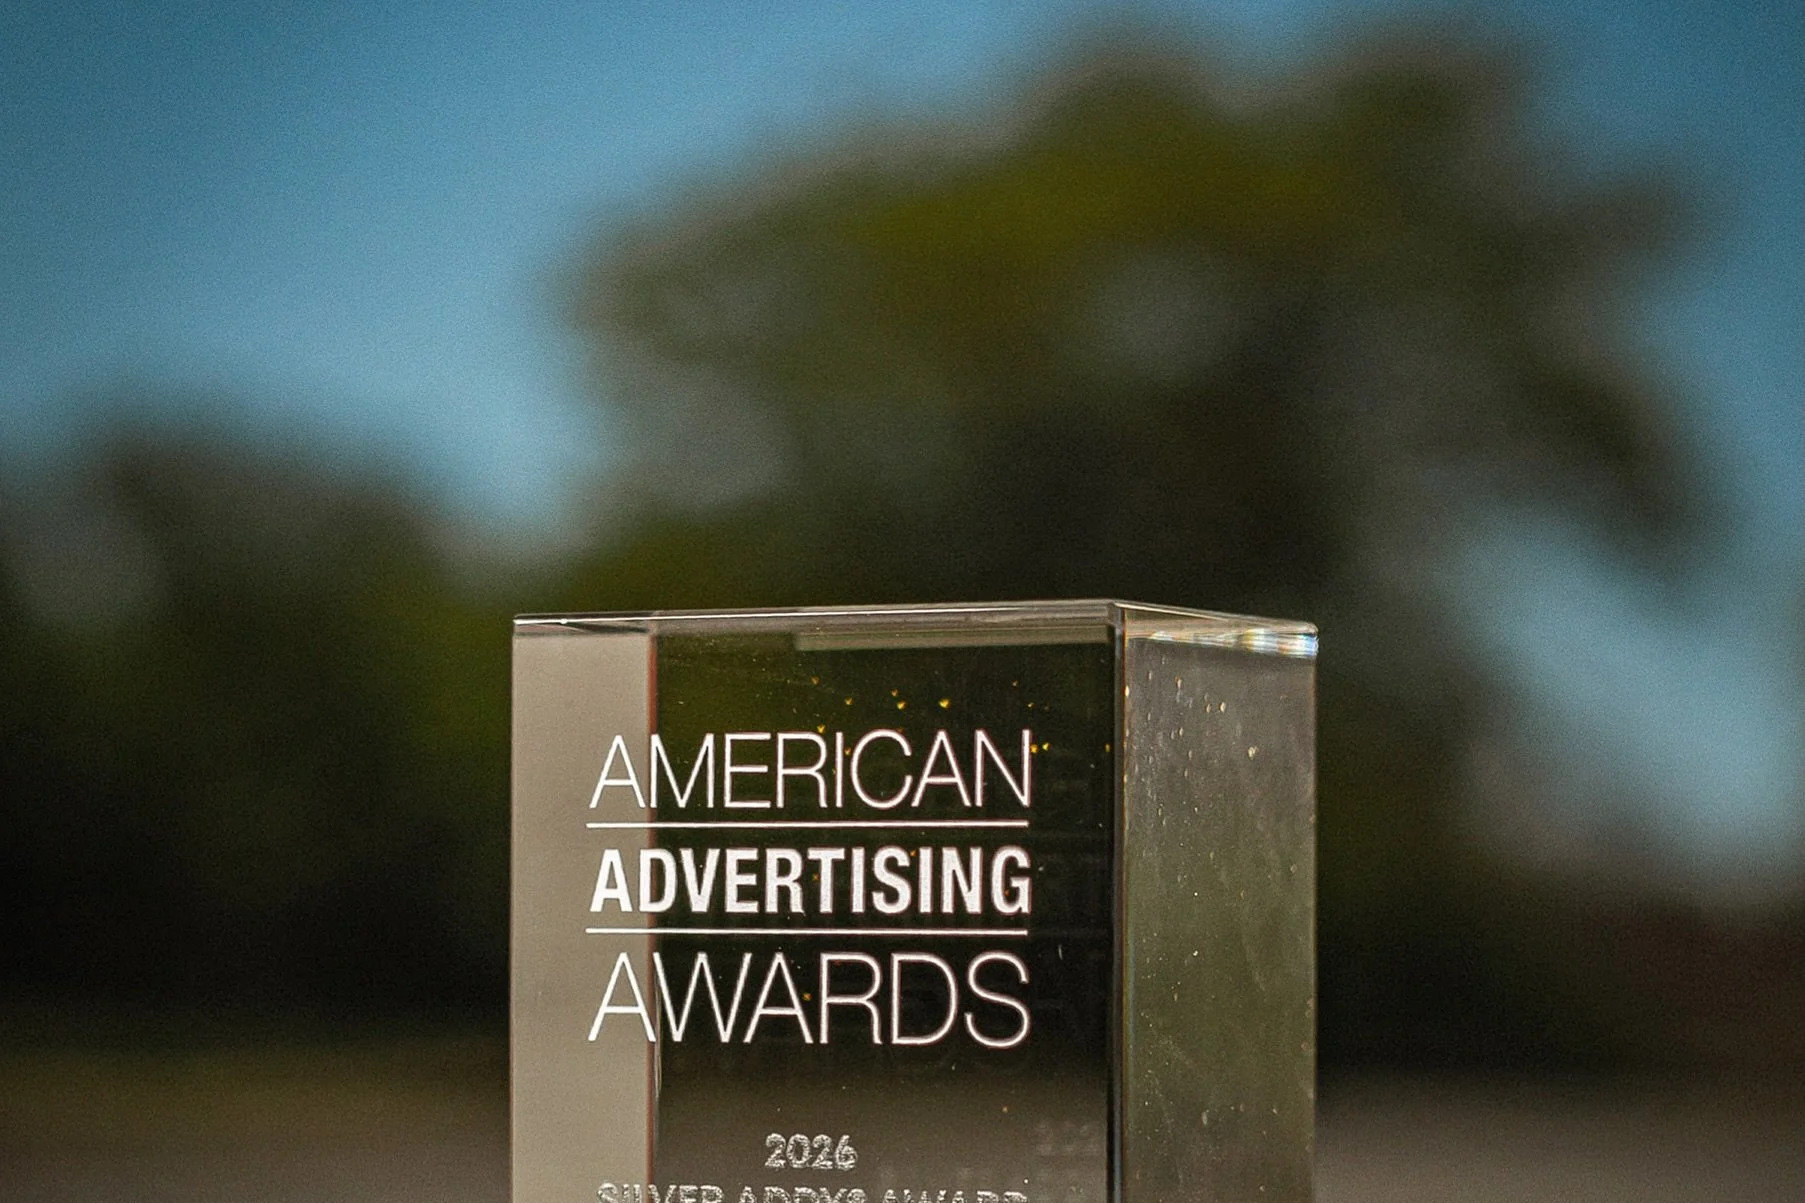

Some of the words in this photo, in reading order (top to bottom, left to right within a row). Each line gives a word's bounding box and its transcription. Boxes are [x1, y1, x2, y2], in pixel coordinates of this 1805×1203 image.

[589, 729, 1031, 809] AMERICAN
[589, 846, 1031, 914] ADVERTISING
[587, 951, 1030, 1047] AWARDS
[764, 1133, 858, 1171] 2026
